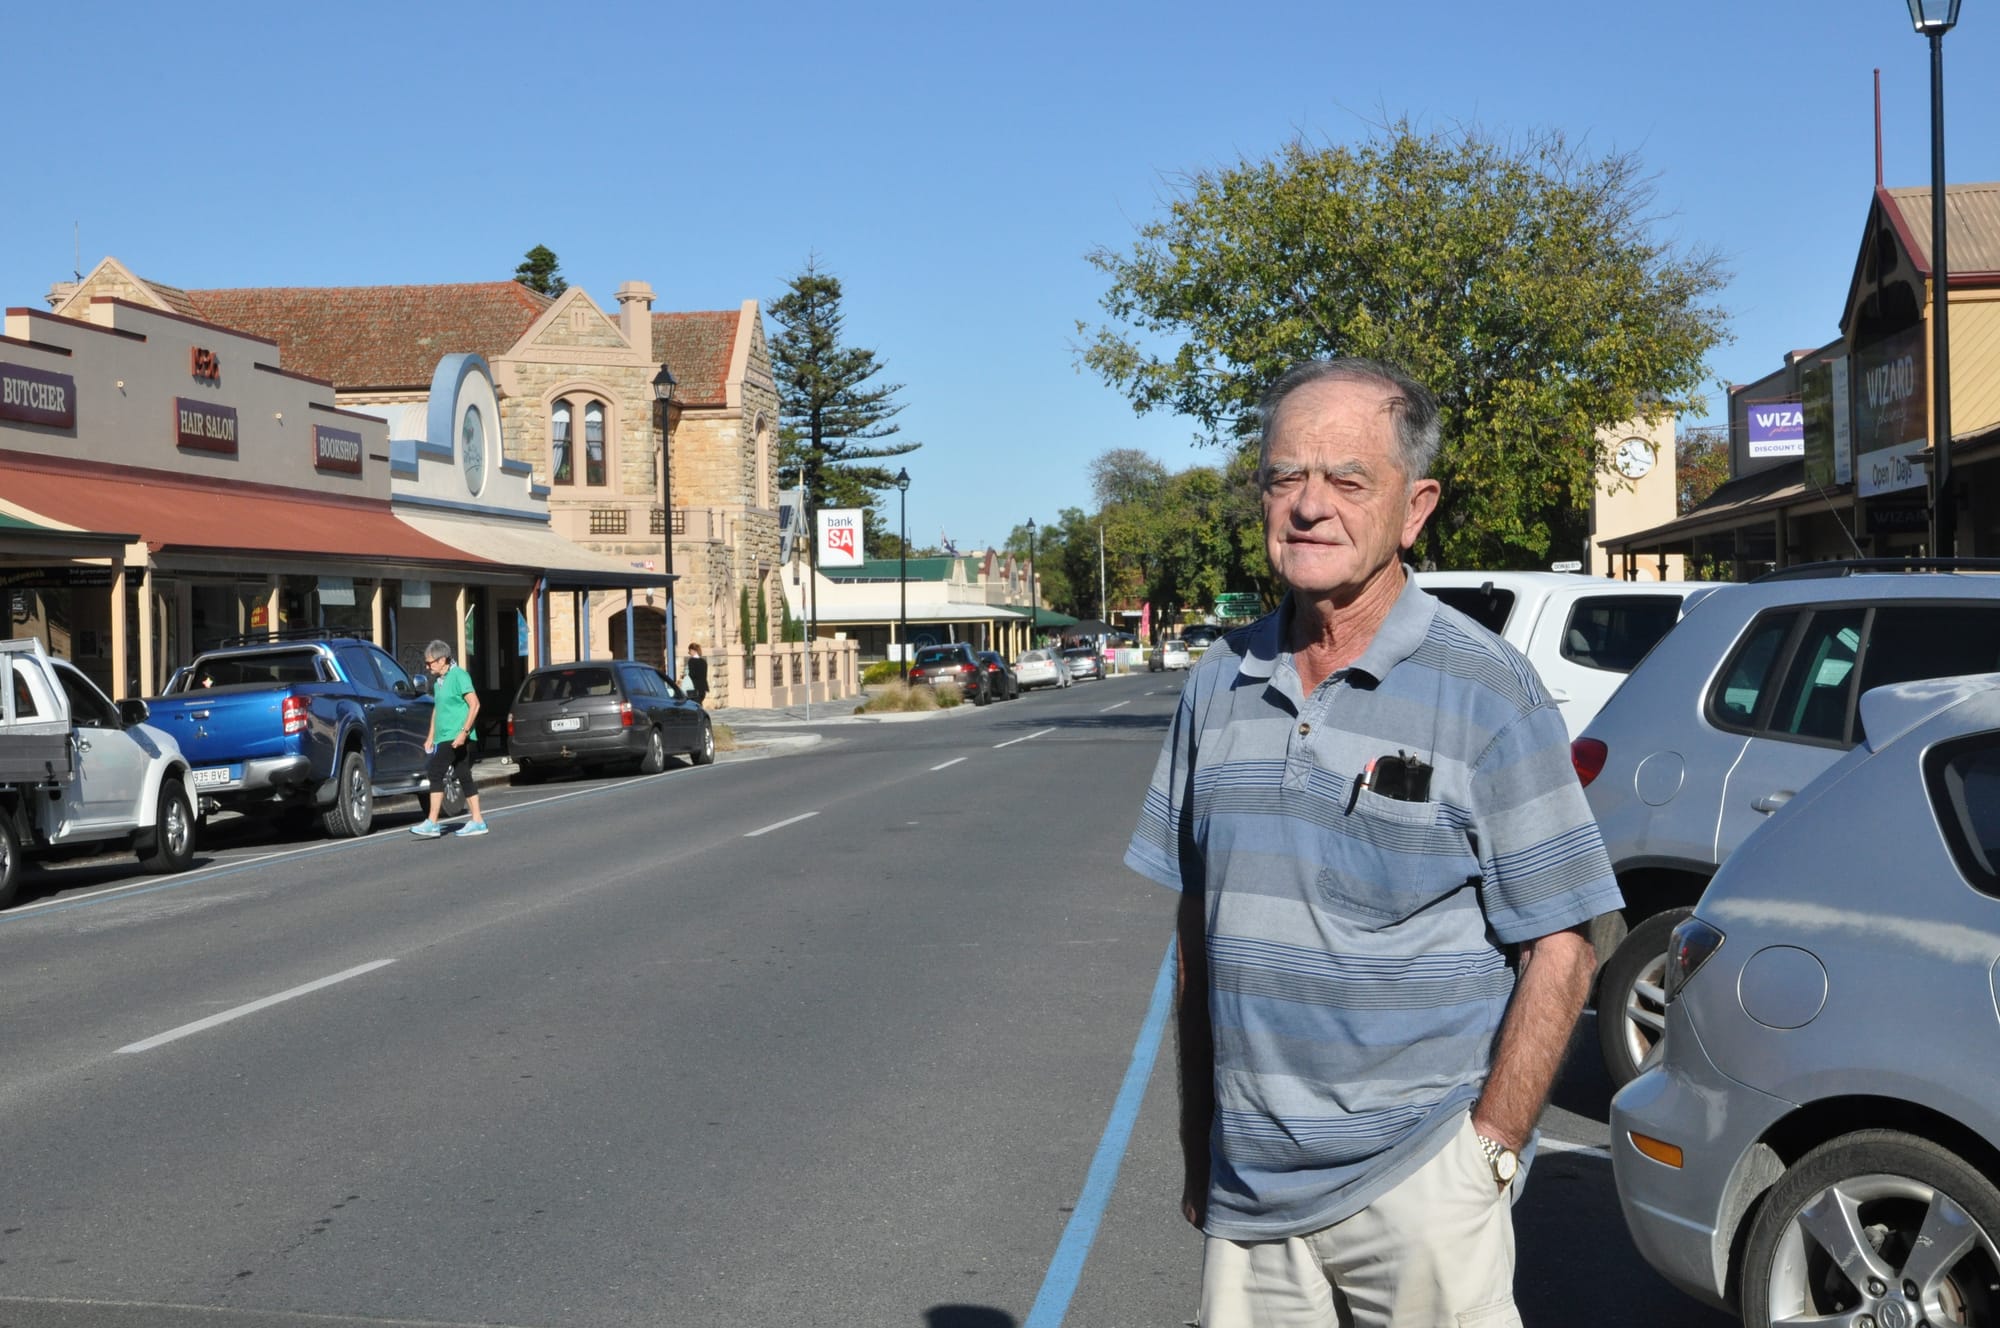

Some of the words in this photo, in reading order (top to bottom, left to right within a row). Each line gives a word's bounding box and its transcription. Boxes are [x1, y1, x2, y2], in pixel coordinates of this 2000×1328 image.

[1866, 355, 1913, 408] WIZARD
[3, 377, 66, 413] BUTCHER
[180, 410, 204, 435] HAIR
[206, 415, 234, 441] SALON
[1756, 411, 1803, 427] WIZA
[320, 436, 359, 462] BOOKSHOP
[1873, 463, 1889, 489] Open
[1889, 455, 1896, 489] 7
[1896, 458, 1913, 486] Days
[828, 516, 853, 527] bank
[829, 530, 853, 547] SA
[211, 769, 229, 780] BVE
